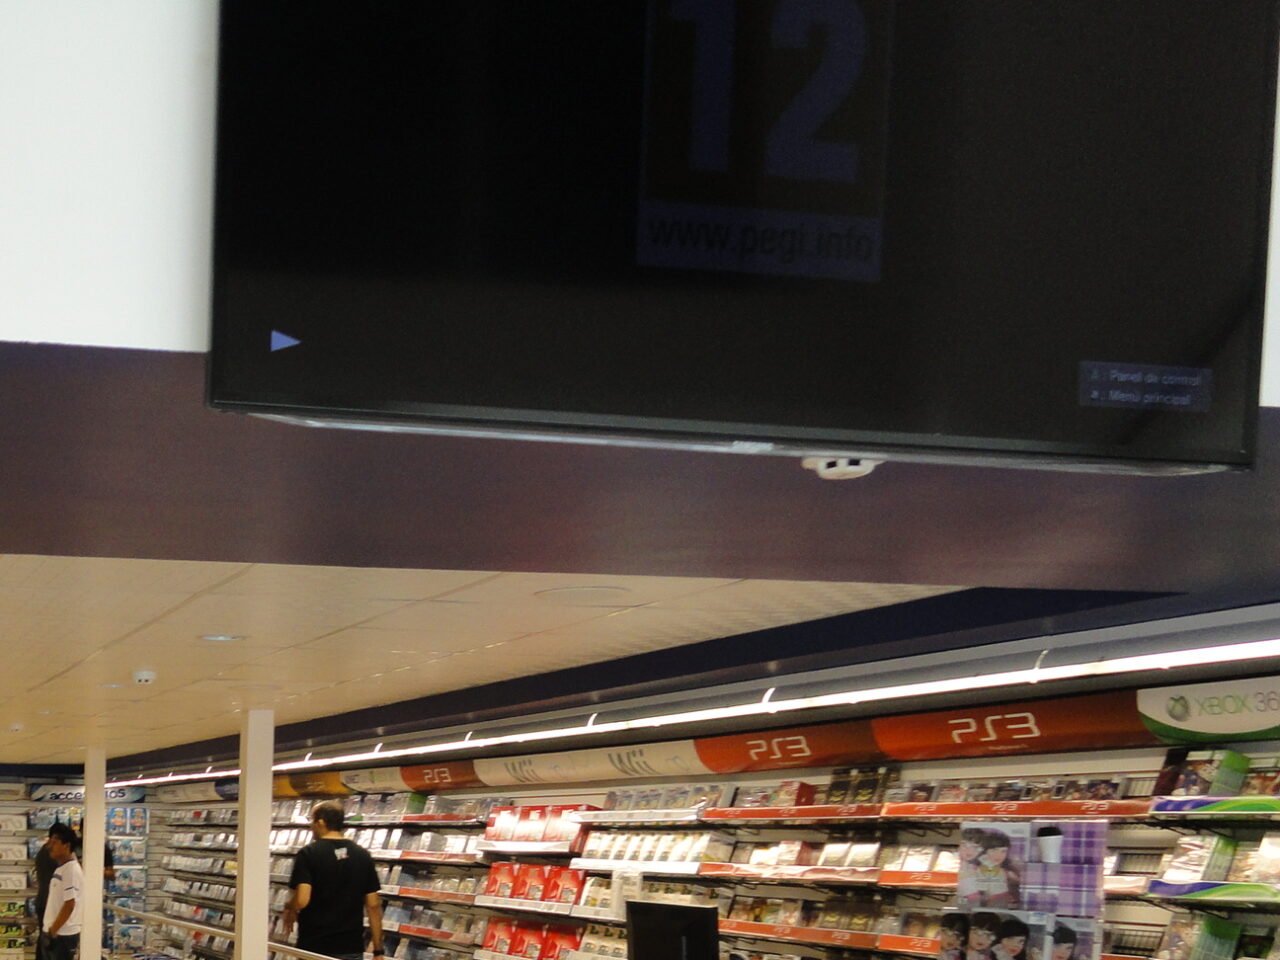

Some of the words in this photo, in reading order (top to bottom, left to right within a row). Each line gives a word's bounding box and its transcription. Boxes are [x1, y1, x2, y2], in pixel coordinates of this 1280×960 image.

[668, 0, 867, 184] 12
[646, 219, 872, 264] www.pegi.info
[1195, 693, 1252, 716] XBOX
[948, 712, 1041, 743] PS3
[746, 735, 811, 760] PS3
[423, 767, 452, 783] PS3
[606, 748, 664, 777] Wii
